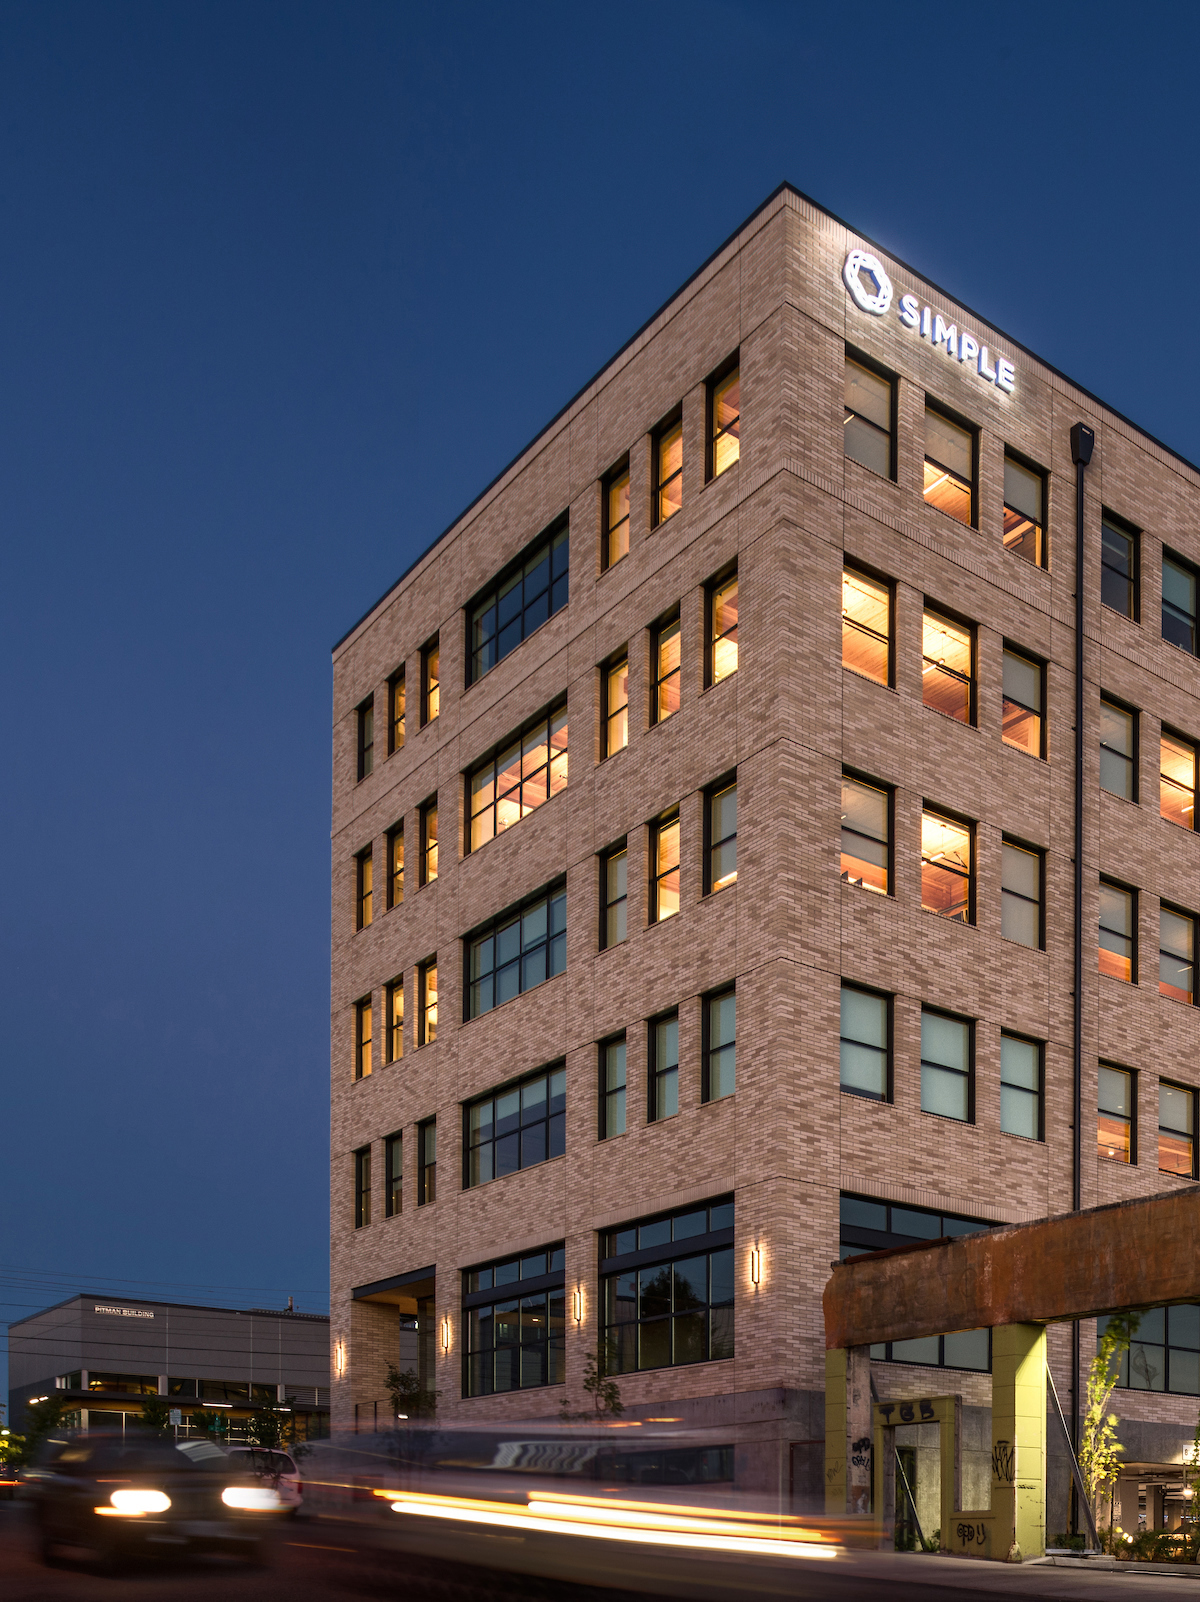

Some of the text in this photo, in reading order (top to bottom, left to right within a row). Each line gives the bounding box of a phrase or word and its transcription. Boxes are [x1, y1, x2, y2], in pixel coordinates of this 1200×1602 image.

[900, 294, 1015, 394] SIMPLE
[94, 1306, 154, 1318] PITMAN BUILDING
